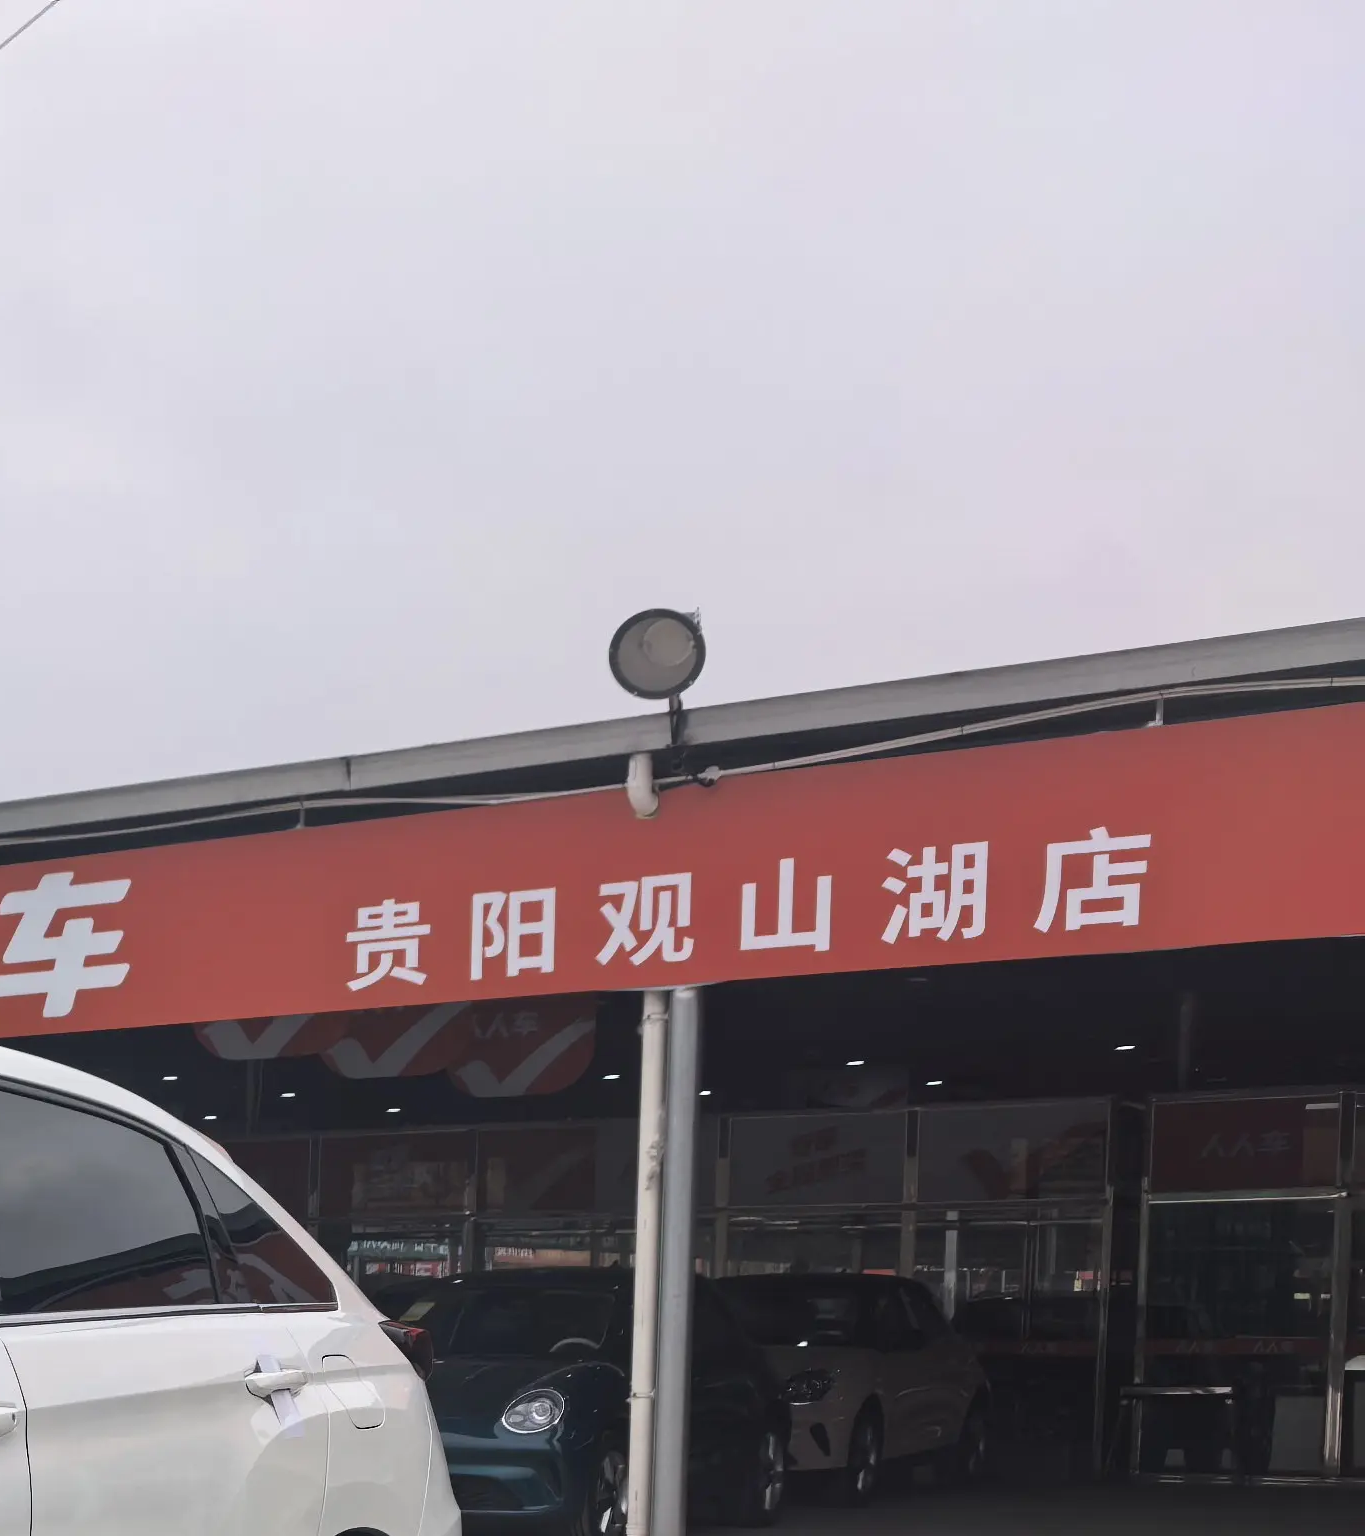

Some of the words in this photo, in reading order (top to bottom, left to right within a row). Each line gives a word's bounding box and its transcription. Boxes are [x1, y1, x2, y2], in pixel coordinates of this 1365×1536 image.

[344, 827, 1153, 991] 贵阳观山湖店
[1199, 1130, 1291, 1160] 人人车
